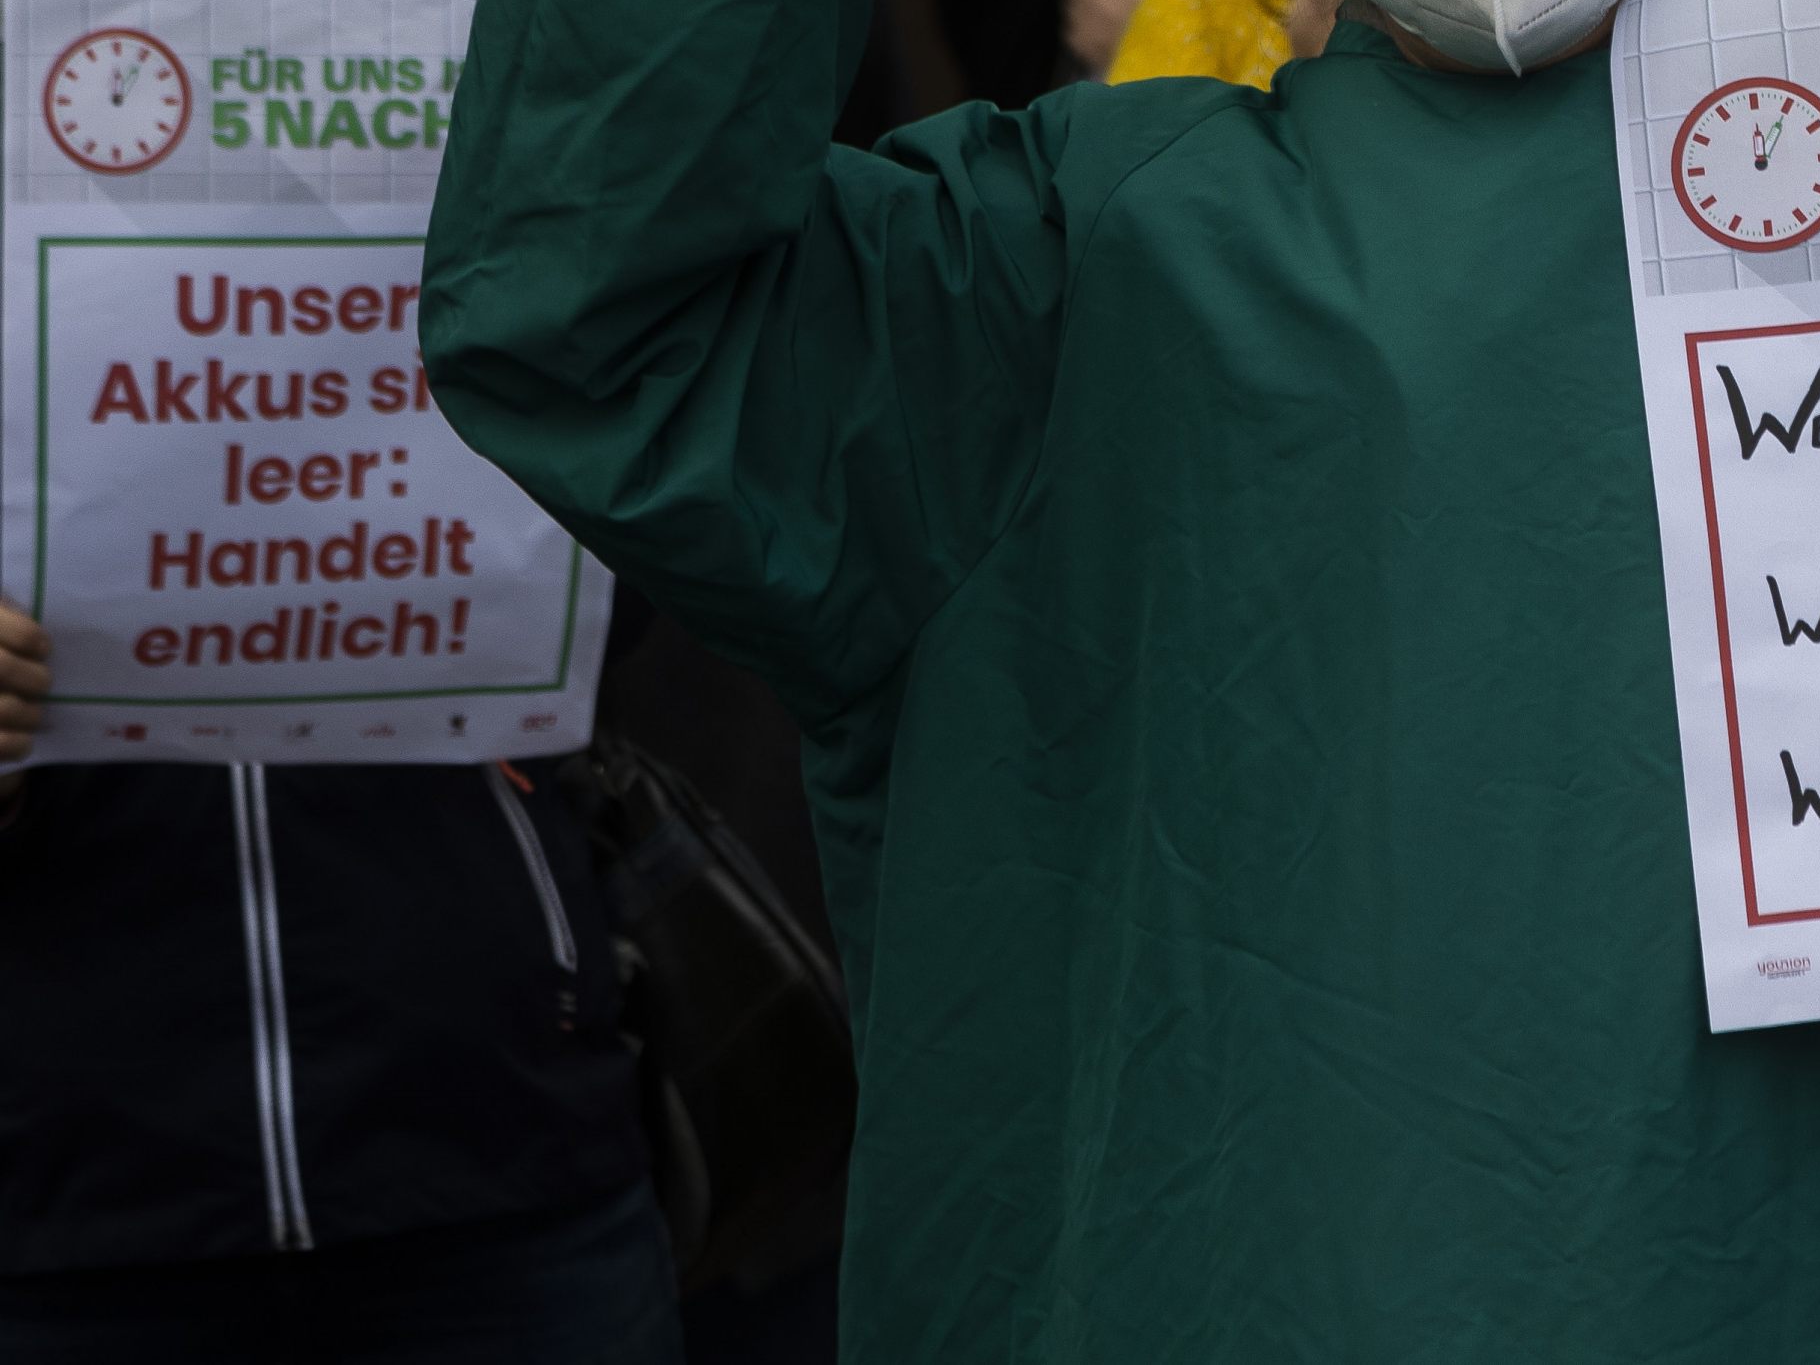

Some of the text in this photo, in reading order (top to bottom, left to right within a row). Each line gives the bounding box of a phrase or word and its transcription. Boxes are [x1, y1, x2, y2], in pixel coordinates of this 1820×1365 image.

[211, 47, 304, 94] FÜR
[323, 57, 425, 94] UNS
[211, 98, 251, 149] 5
[90, 358, 350, 424] Akkus
[223, 442, 410, 506] leer:
[147, 516, 475, 591] Handelt
[132, 597, 472, 668] endlich!
